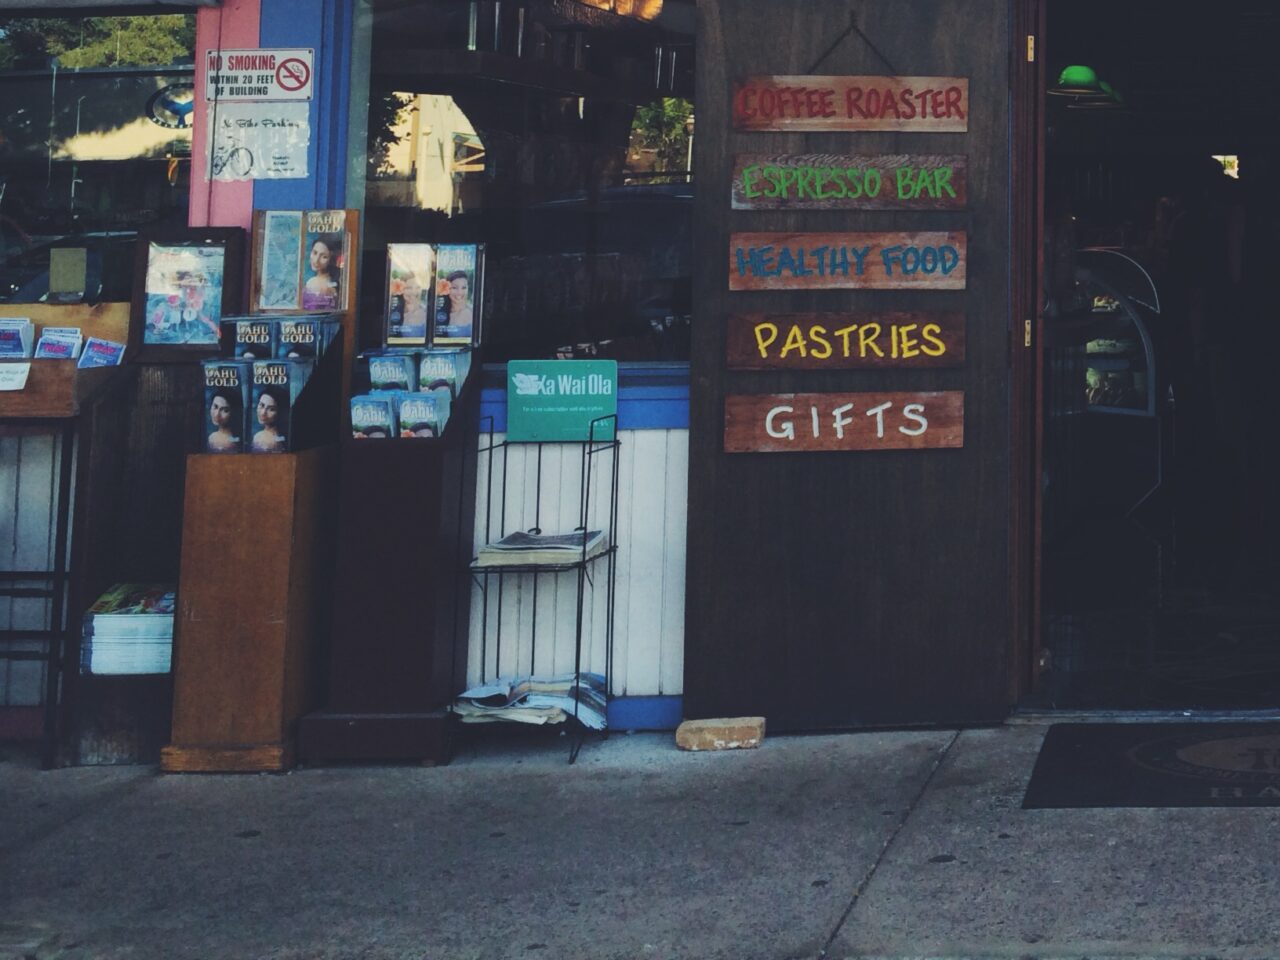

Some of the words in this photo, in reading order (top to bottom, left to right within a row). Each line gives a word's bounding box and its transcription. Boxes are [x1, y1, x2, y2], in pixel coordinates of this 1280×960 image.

[209, 55, 223, 71] NO
[228, 54, 276, 71] SMOKING
[242, 75, 253, 84] 20
[256, 74, 275, 84] FEET
[215, 86, 225, 96] OF
[229, 86, 269, 96] BUILDING
[739, 86, 837, 120] COFFEE
[845, 86, 965, 120] ROASTER
[742, 162, 881, 200] ESPRESSO
[896, 166, 957, 200] BAR
[308, 224, 341, 233] GOLD
[736, 245, 871, 278] HEALTHY
[881, 245, 959, 277] FOOD
[236, 324, 269, 335] OAHU
[281, 324, 314, 334] OAHU
[236, 334, 270, 344] GOLD
[281, 333, 315, 344] GOLD
[755, 322, 946, 359] PASTRIES
[205, 367, 238, 378] OAHU
[253, 366, 287, 377] OAHU
[205, 377, 239, 387] GOLD
[253, 375, 287, 385] GOLD
[557, 374, 586, 395] Wai
[588, 373, 612, 395] Ola
[765, 401, 928, 440] GIFTS
